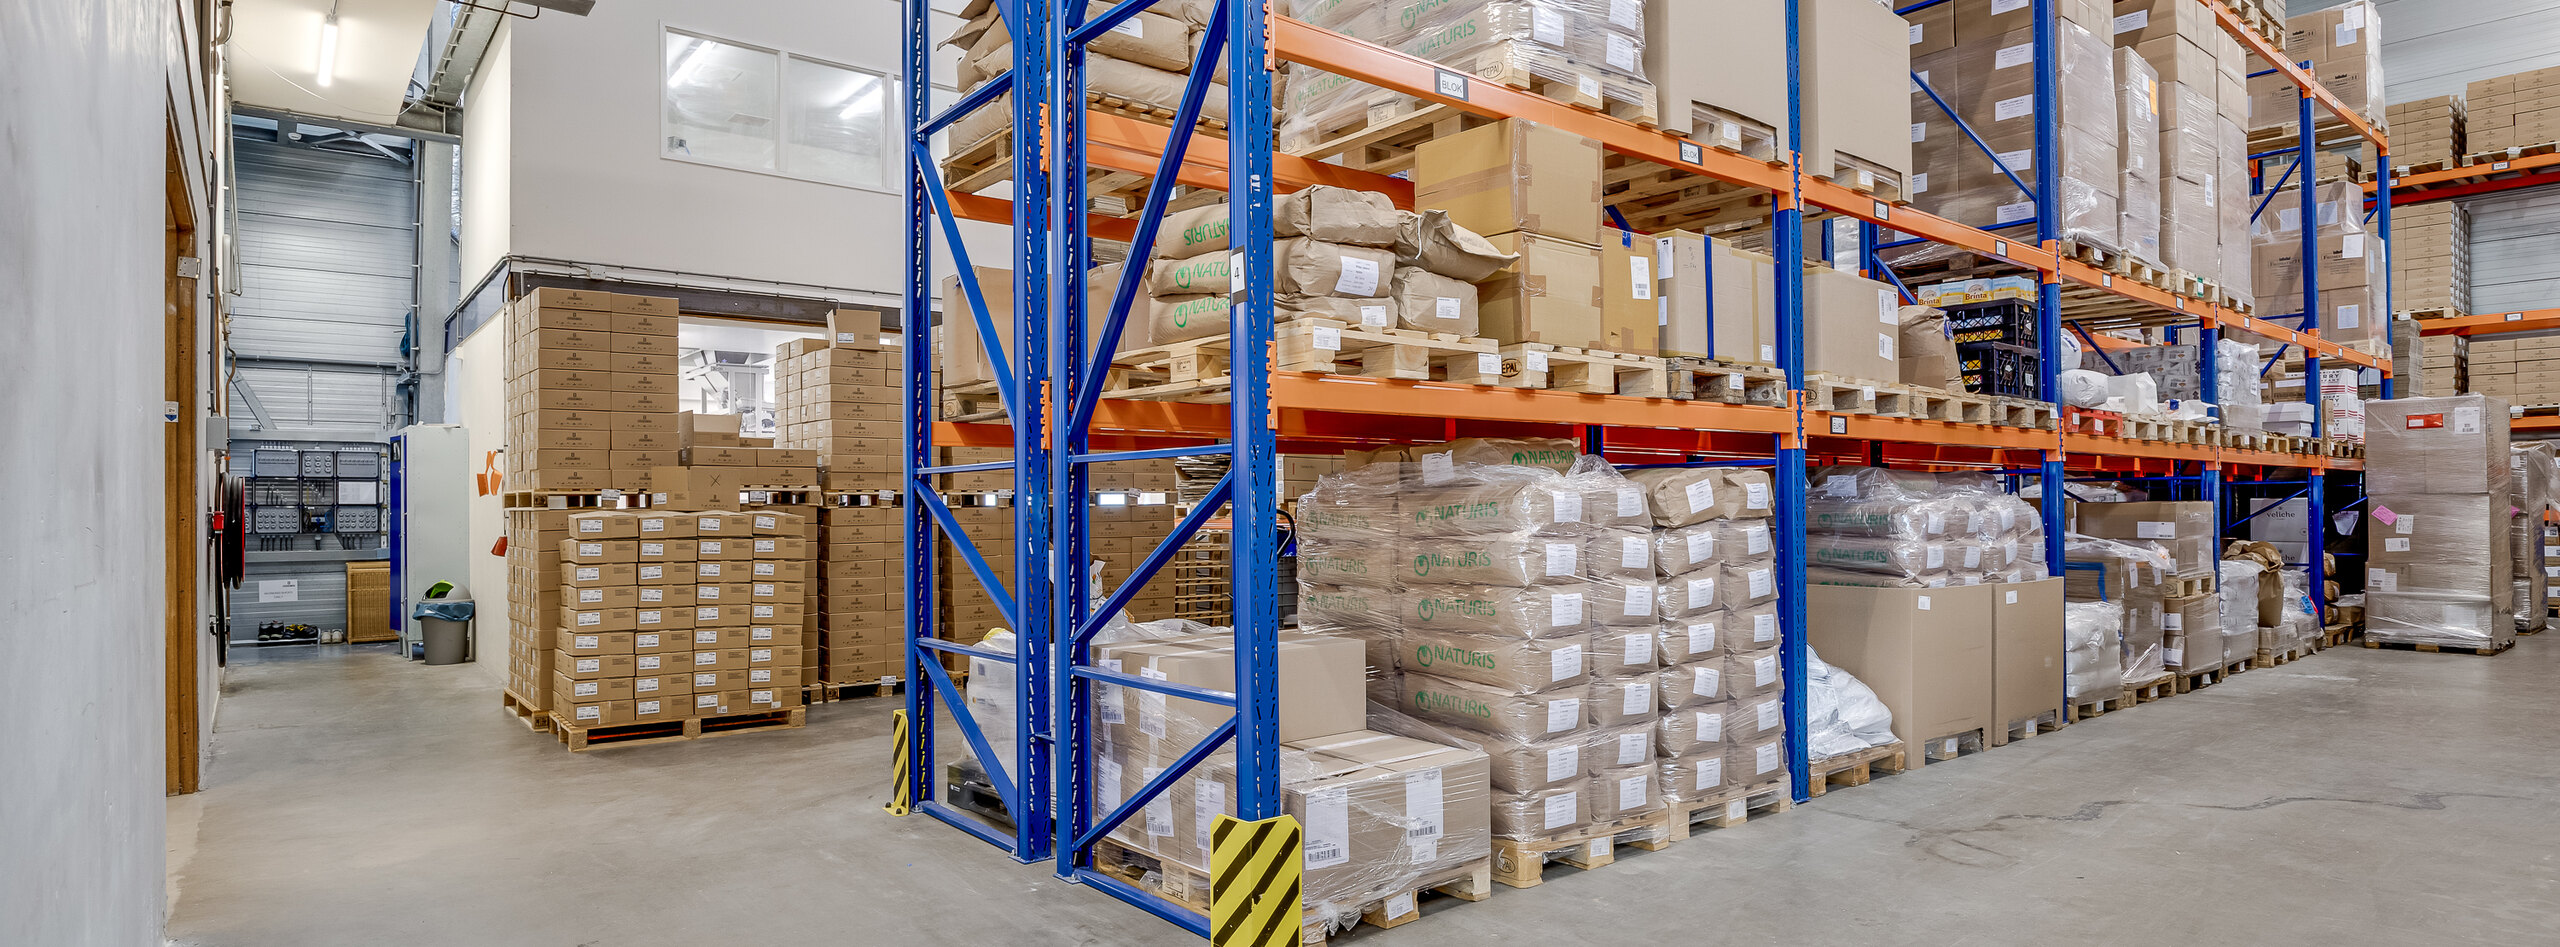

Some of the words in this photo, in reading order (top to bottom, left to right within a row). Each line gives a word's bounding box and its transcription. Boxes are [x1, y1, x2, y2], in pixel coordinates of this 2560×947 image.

[1416, 18, 1476, 57] NATURIS
[1441, 81, 1463, 93] BLOK
[1683, 149, 1698, 159] BLOK
[1234, 266, 1240, 280] 4
[1918, 297, 1940, 306] Brinta
[1965, 292, 1987, 301] Brinta
[1527, 449, 1575, 465] NATURIS
[1434, 501, 1499, 521] NATURIS
[1430, 551, 1492, 569] NATURIS
[1832, 548, 1888, 563] NATURIS
[1318, 557, 1368, 575] NATURIS
[1434, 598, 1497, 617] NATURIS
[1433, 645, 1496, 670] NATURIS
[1430, 690, 1492, 719] NATURIS
